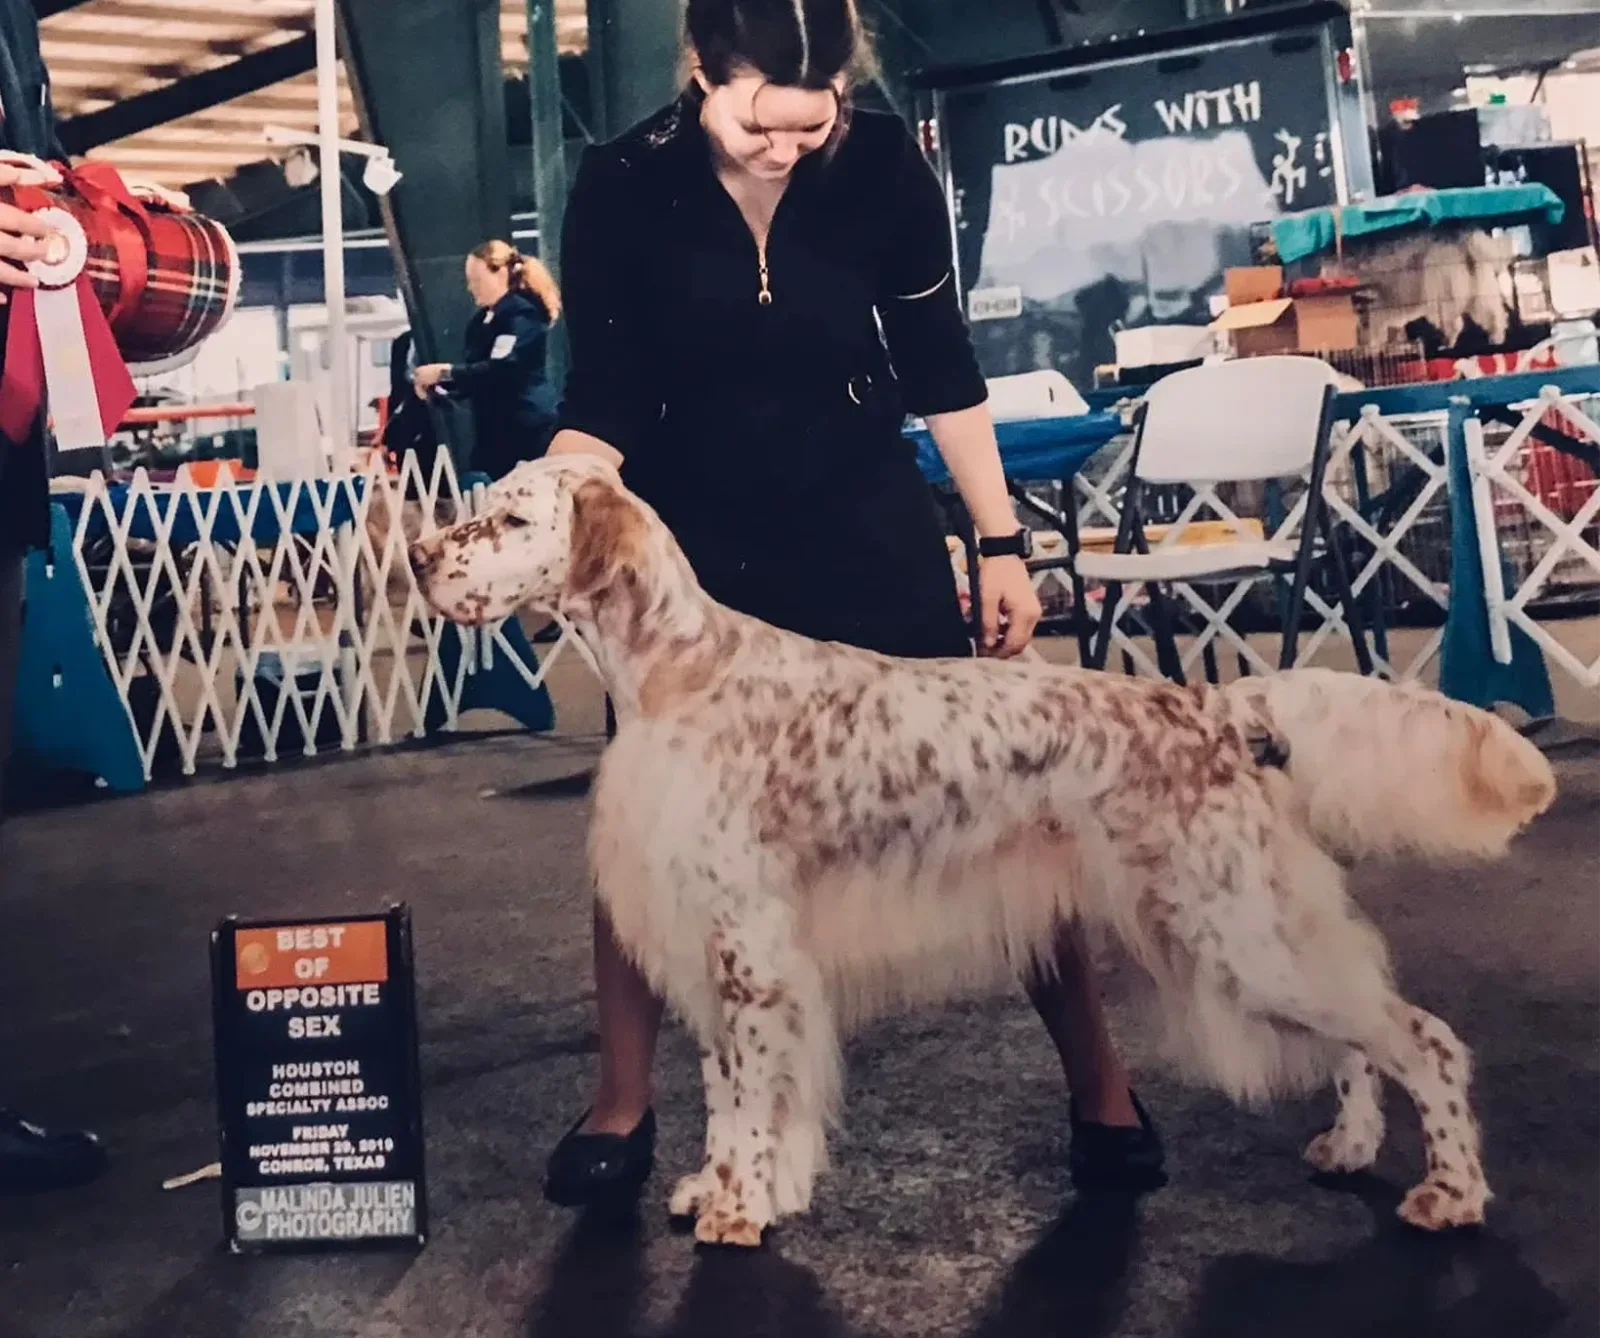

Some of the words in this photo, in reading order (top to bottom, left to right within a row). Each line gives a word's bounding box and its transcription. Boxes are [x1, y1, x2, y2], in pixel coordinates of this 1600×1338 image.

[1154, 81, 1261, 134] WITH
[1040, 156, 1242, 227] SCISSORS
[276, 927, 345, 951] BEST
[294, 957, 329, 979] OF
[247, 983, 380, 1011] OPPOSITE
[288, 1015, 341, 1039] SEX
[272, 1060, 360, 1079] HOUSTON
[269, 1079, 365, 1098] COMBINED
[246, 1099, 332, 1116] SPECIALTY
[335, 1096, 389, 1112] ASSOC
[292, 1124, 349, 1141] FRIDAY
[249, 1142, 330, 1158] NOVEMBER
[332, 1155, 386, 1170] TEXAS
[260, 1187, 346, 1212] MALINDA
[349, 1182, 415, 1209] JULIEN
[265, 1209, 411, 1238] PHOTOGRAPHY
